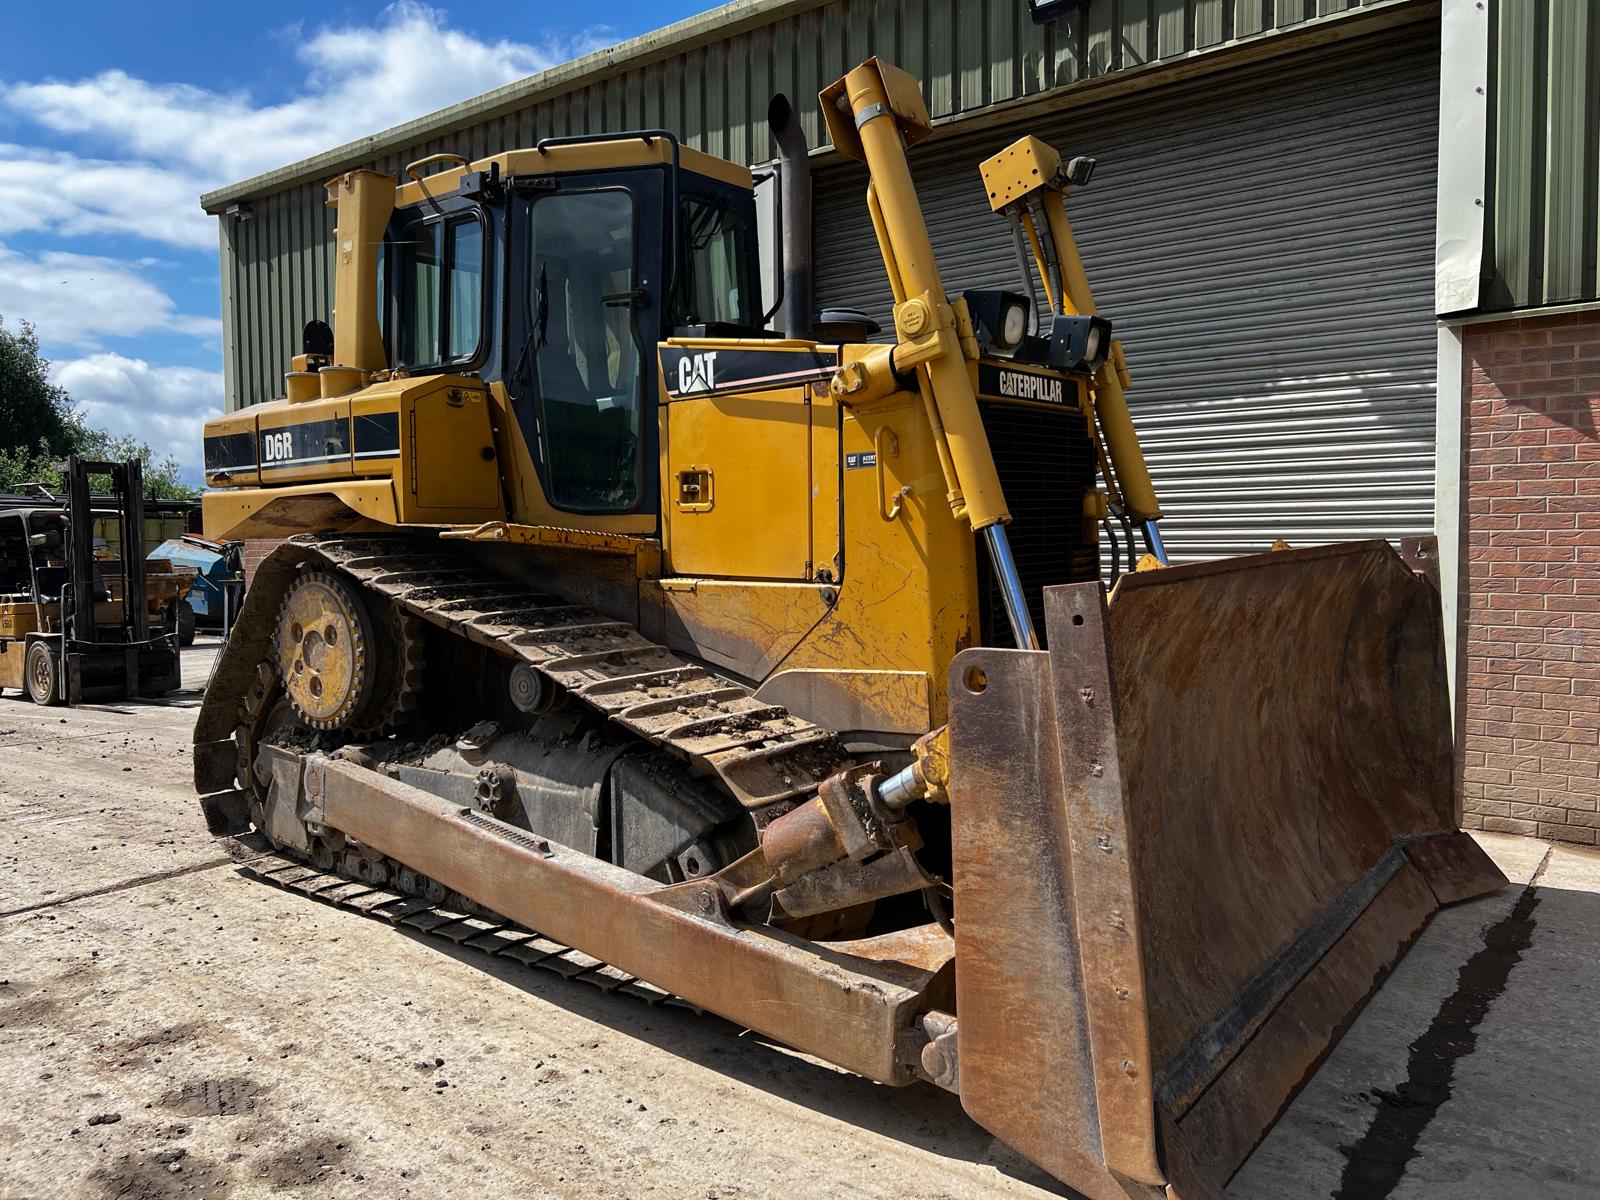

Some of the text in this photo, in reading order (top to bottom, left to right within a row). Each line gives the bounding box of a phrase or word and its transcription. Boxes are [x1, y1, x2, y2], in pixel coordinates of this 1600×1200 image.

[679, 351, 717, 393] CAT
[1000, 371, 1062, 402] CATERPILLAR
[265, 432, 293, 460] D6R
[848, 455, 856, 463] CAT
